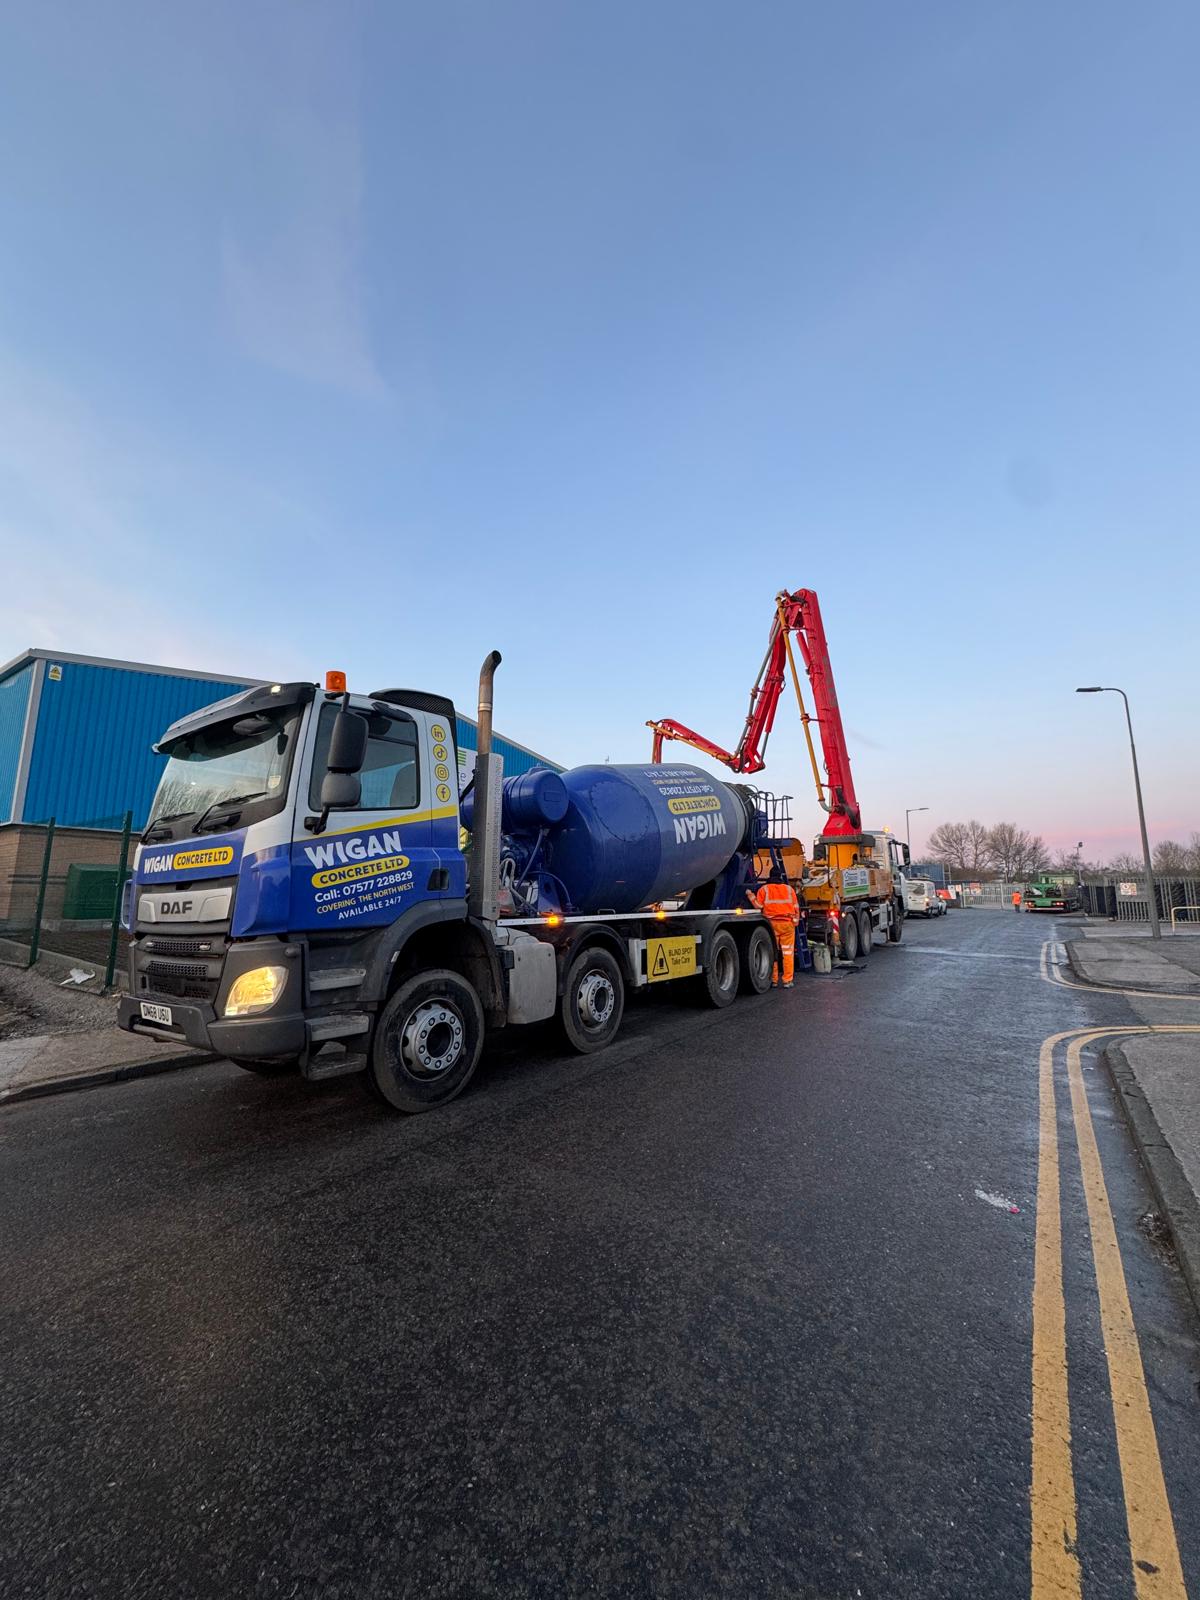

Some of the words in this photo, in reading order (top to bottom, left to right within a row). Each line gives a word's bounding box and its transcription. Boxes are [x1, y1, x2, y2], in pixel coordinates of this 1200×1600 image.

[672, 802, 687, 812] LTD
[687, 798, 718, 811] CONCRETE
[673, 813, 727, 845] WIGAN
[177, 853, 212, 866] CONCRETE
[213, 850, 229, 862] LTD
[304, 831, 402, 869] WIGAN
[144, 854, 174, 874] WIGAN
[320, 862, 383, 884] CONCRETE
[385, 858, 404, 869] LTD
[315, 888, 341, 903] Call:
[342, 880, 375, 896] 07577
[376, 870, 413, 888] 228829
[316, 897, 357, 914] COVERING
[358, 893, 373, 903] THE
[373, 887, 397, 899] NORTH
[397, 881, 415, 892] WEST
[160, 900, 193, 915] DAF
[338, 901, 384, 920] AVAILABLE
[385, 896, 402, 907] 24/7
[669, 949, 681, 957] BLIND
[682, 947, 693, 955] SPOT
